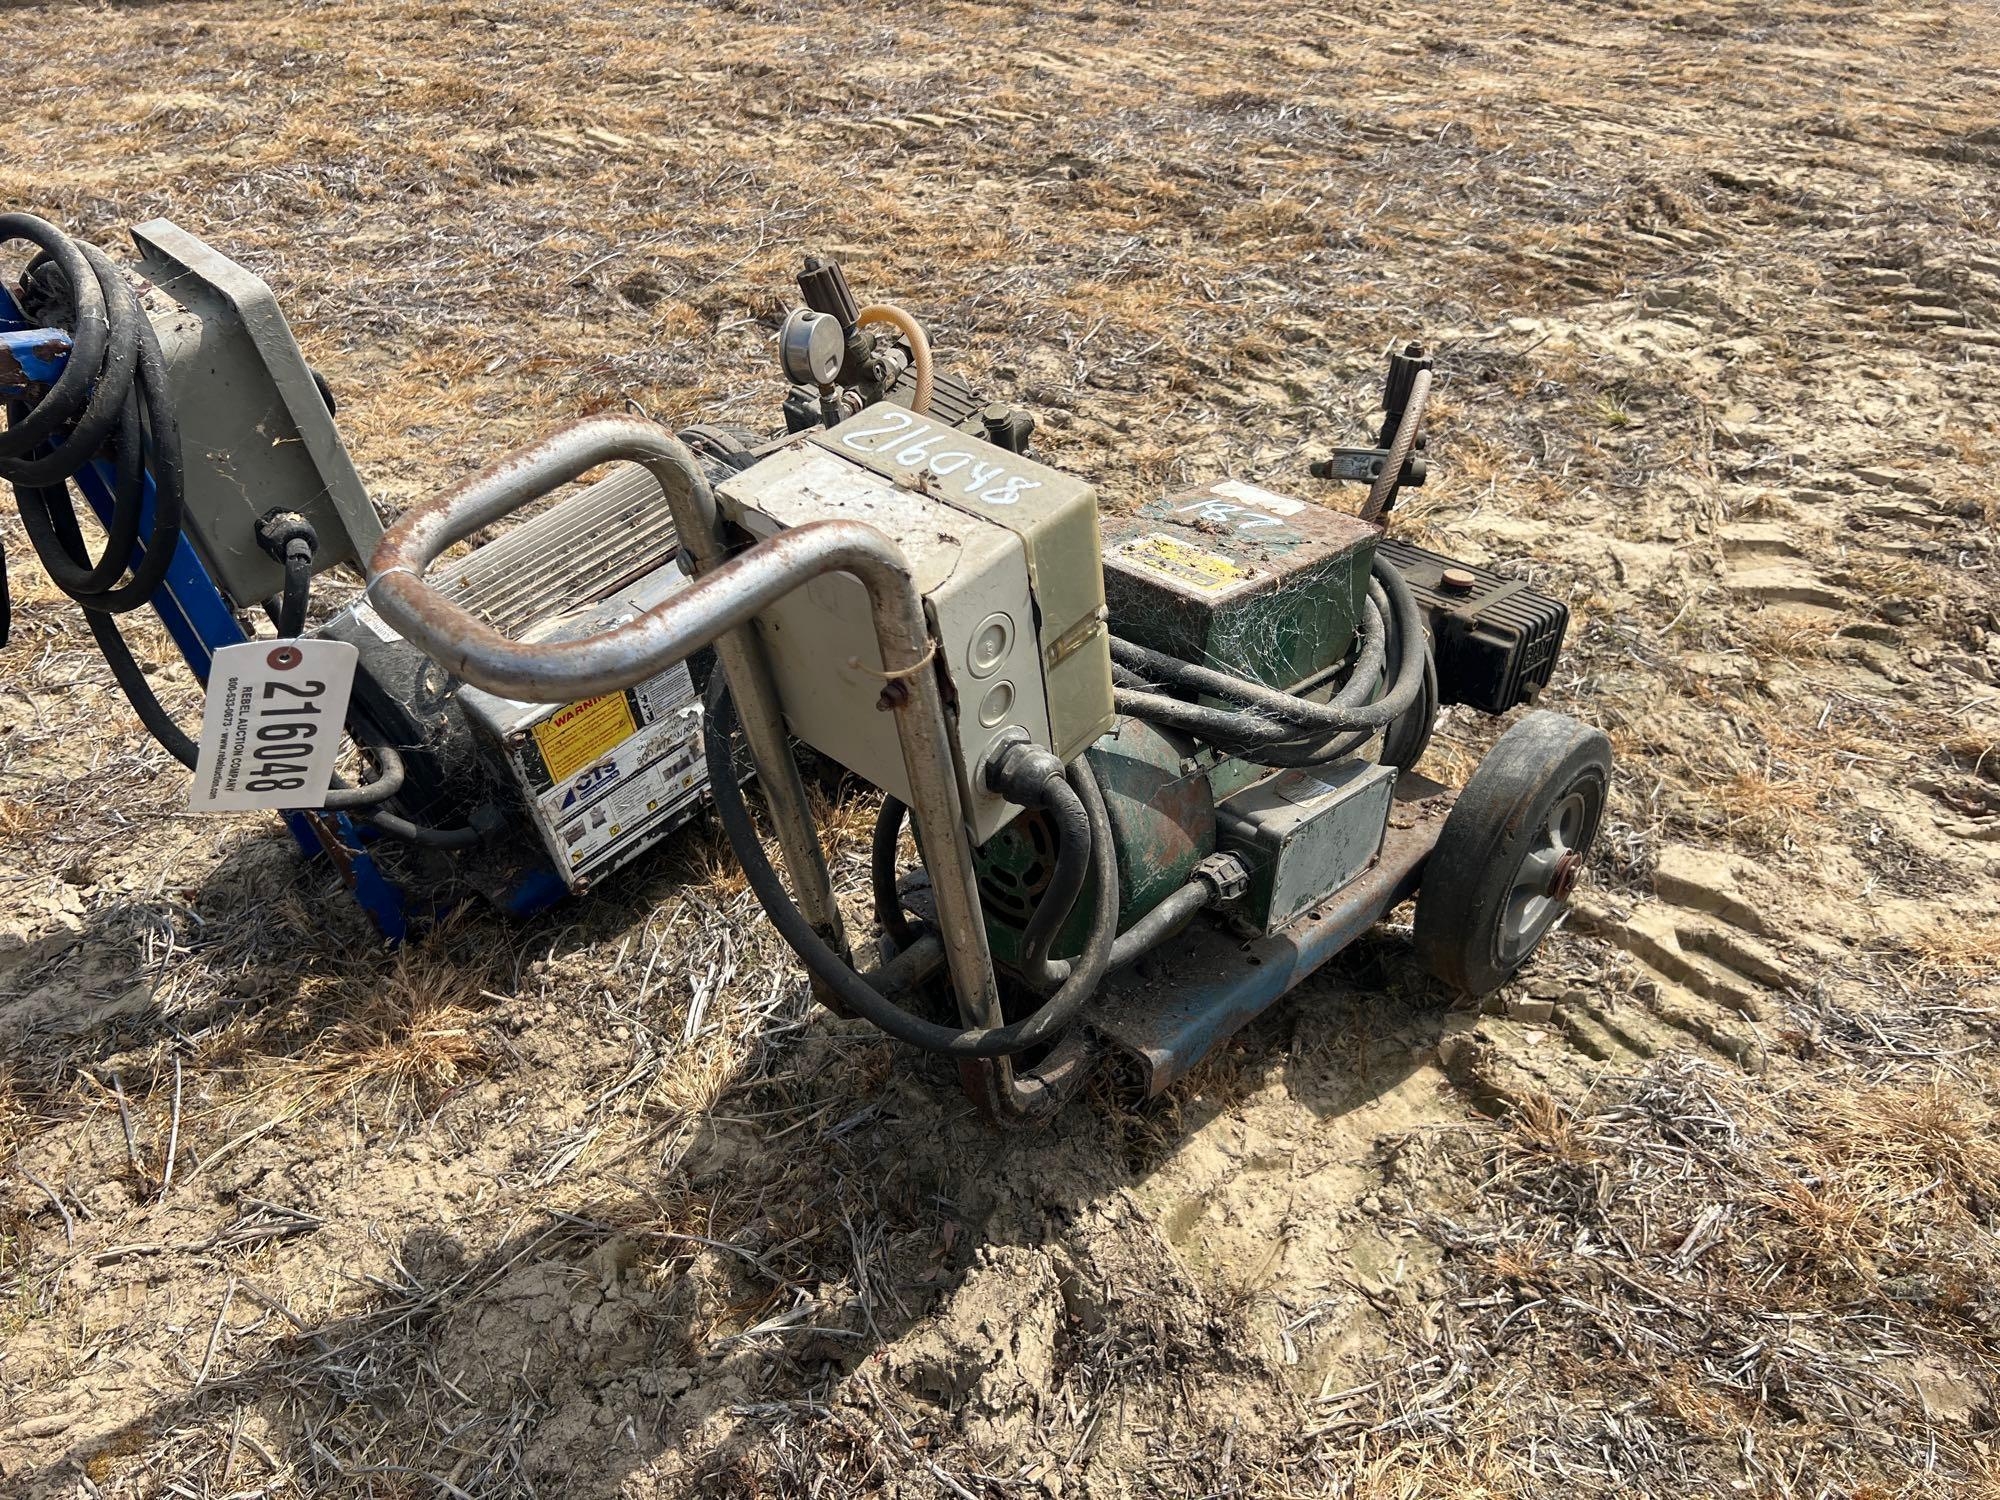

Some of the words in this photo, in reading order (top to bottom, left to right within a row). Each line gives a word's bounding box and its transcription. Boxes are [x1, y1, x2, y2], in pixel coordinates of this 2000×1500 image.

[842, 412, 1042, 505] 216048
[224, 676, 239, 726] 800-533-0673
[239, 686, 253, 715] REBEL
[233, 718, 249, 758] AUCTION
[245, 680, 326, 792] 216048
[208, 732, 229, 800] www.rebelauction.com
[224, 757, 242, 792] COMPANY
